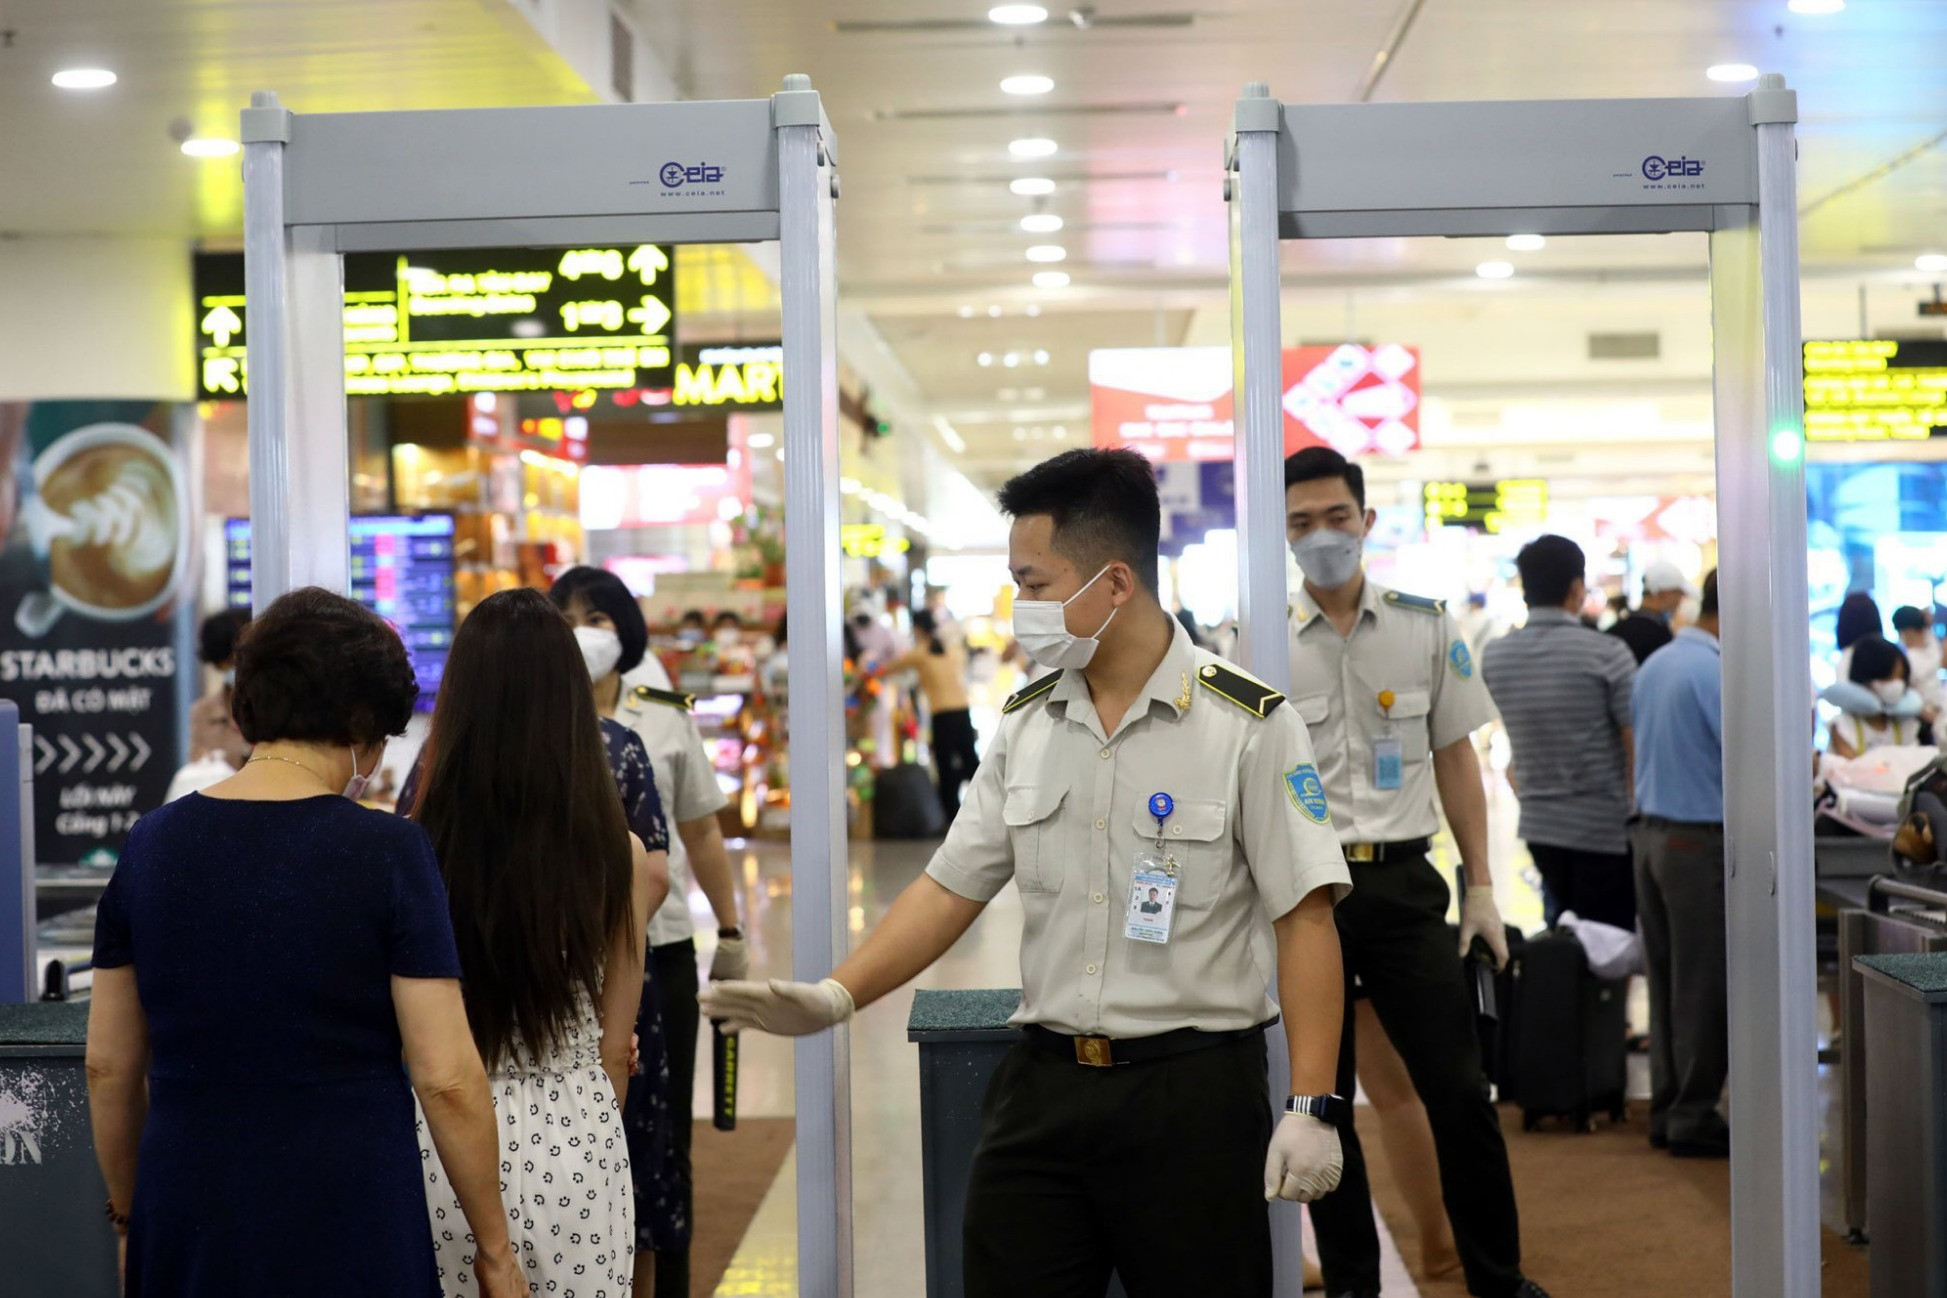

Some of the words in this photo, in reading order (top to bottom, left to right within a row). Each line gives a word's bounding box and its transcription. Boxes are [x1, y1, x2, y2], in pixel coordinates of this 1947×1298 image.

[659, 161, 724, 188] Ceia
[1642, 155, 1704, 181] Ceia
[0, 647, 174, 681] STARBUCKS
[71, 686, 106, 713] CÓ
